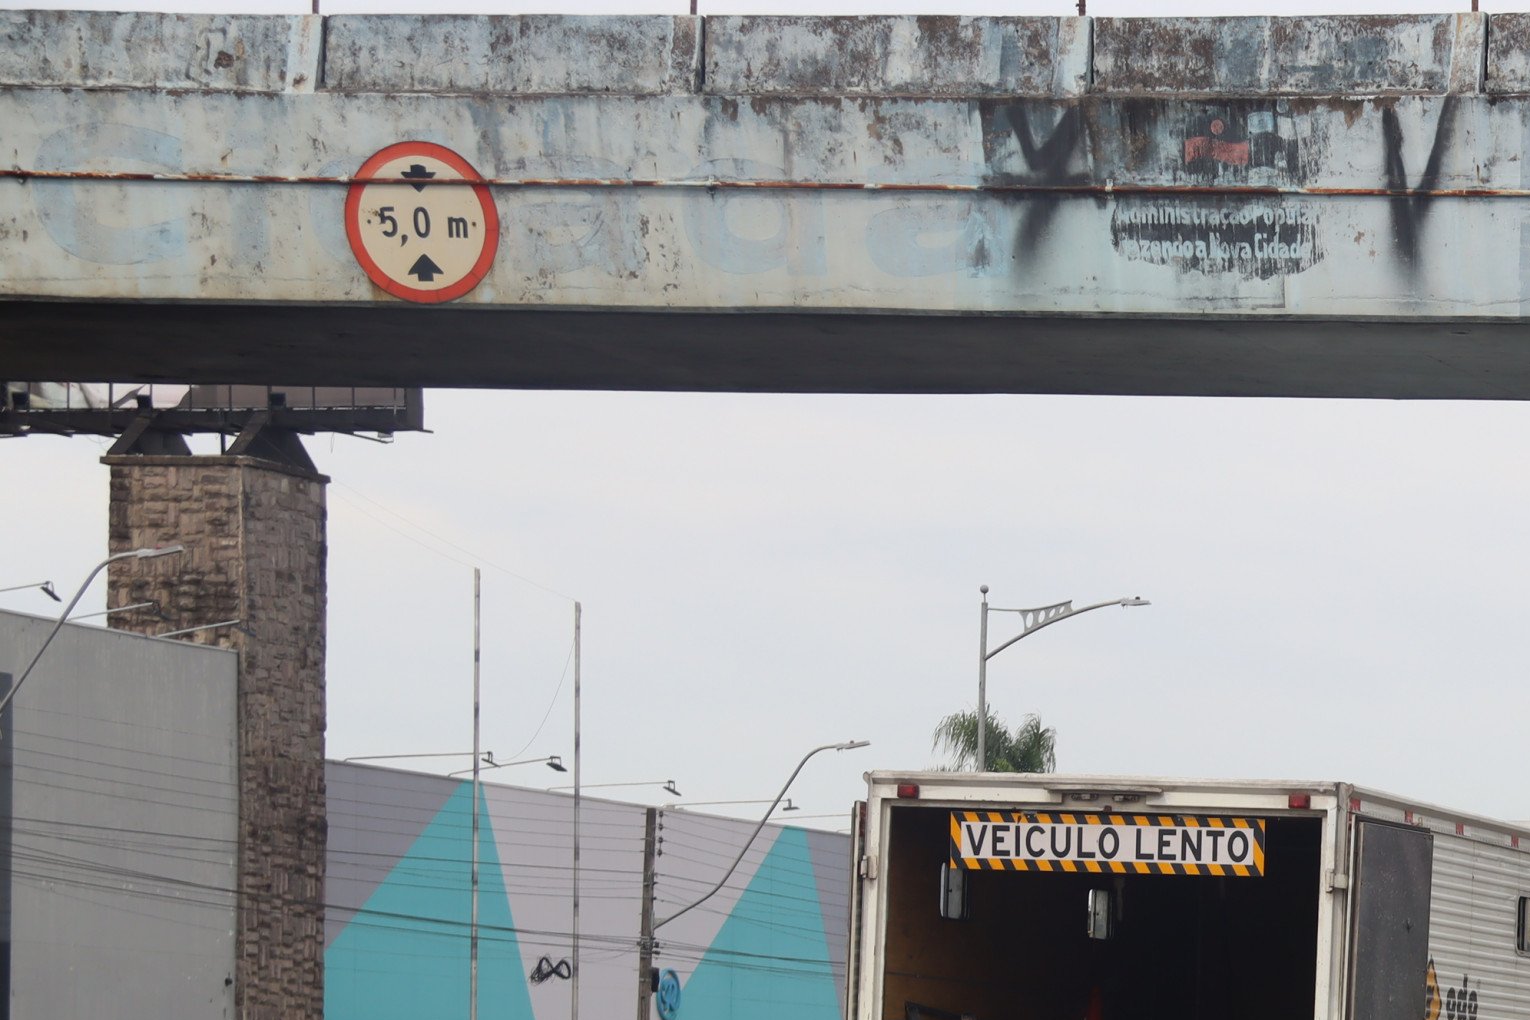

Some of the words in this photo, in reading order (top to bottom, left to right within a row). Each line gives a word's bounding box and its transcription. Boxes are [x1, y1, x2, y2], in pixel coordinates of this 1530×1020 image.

[378, 205, 432, 247] 5,0
[447, 216, 469, 239] m
[965, 817, 1121, 860] VEÍCULO
[1134, 827, 1250, 864] LENTO
